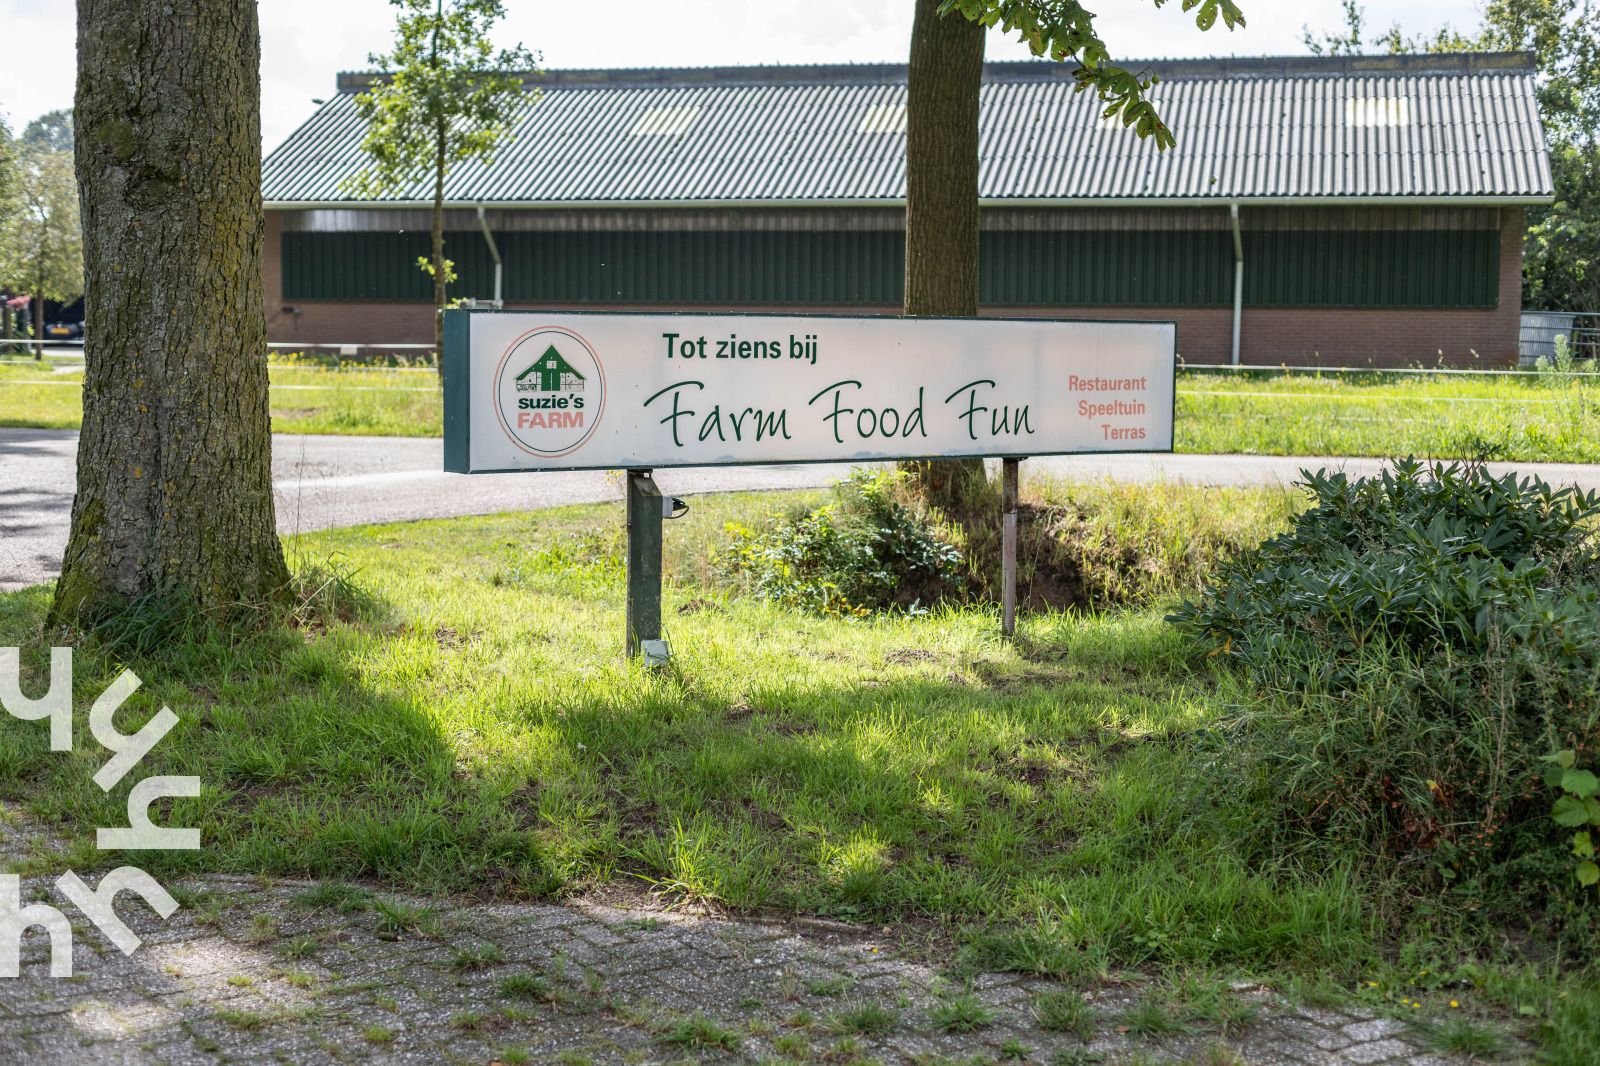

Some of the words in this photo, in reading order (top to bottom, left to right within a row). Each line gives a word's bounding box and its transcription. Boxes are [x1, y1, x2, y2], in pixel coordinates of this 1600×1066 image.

[662, 333, 708, 358] Tot
[715, 334, 782, 359] ziens
[788, 334, 818, 364] bij
[1068, 374, 1147, 392] Restaurant
[517, 393, 585, 410] suzie's
[1078, 399, 1146, 418] Speeltuin
[516, 410, 585, 429] FARM
[643, 380, 792, 447] Farm
[808, 380, 928, 444] Food
[944, 379, 1035, 440] Fun
[1101, 424, 1147, 441] Terras
